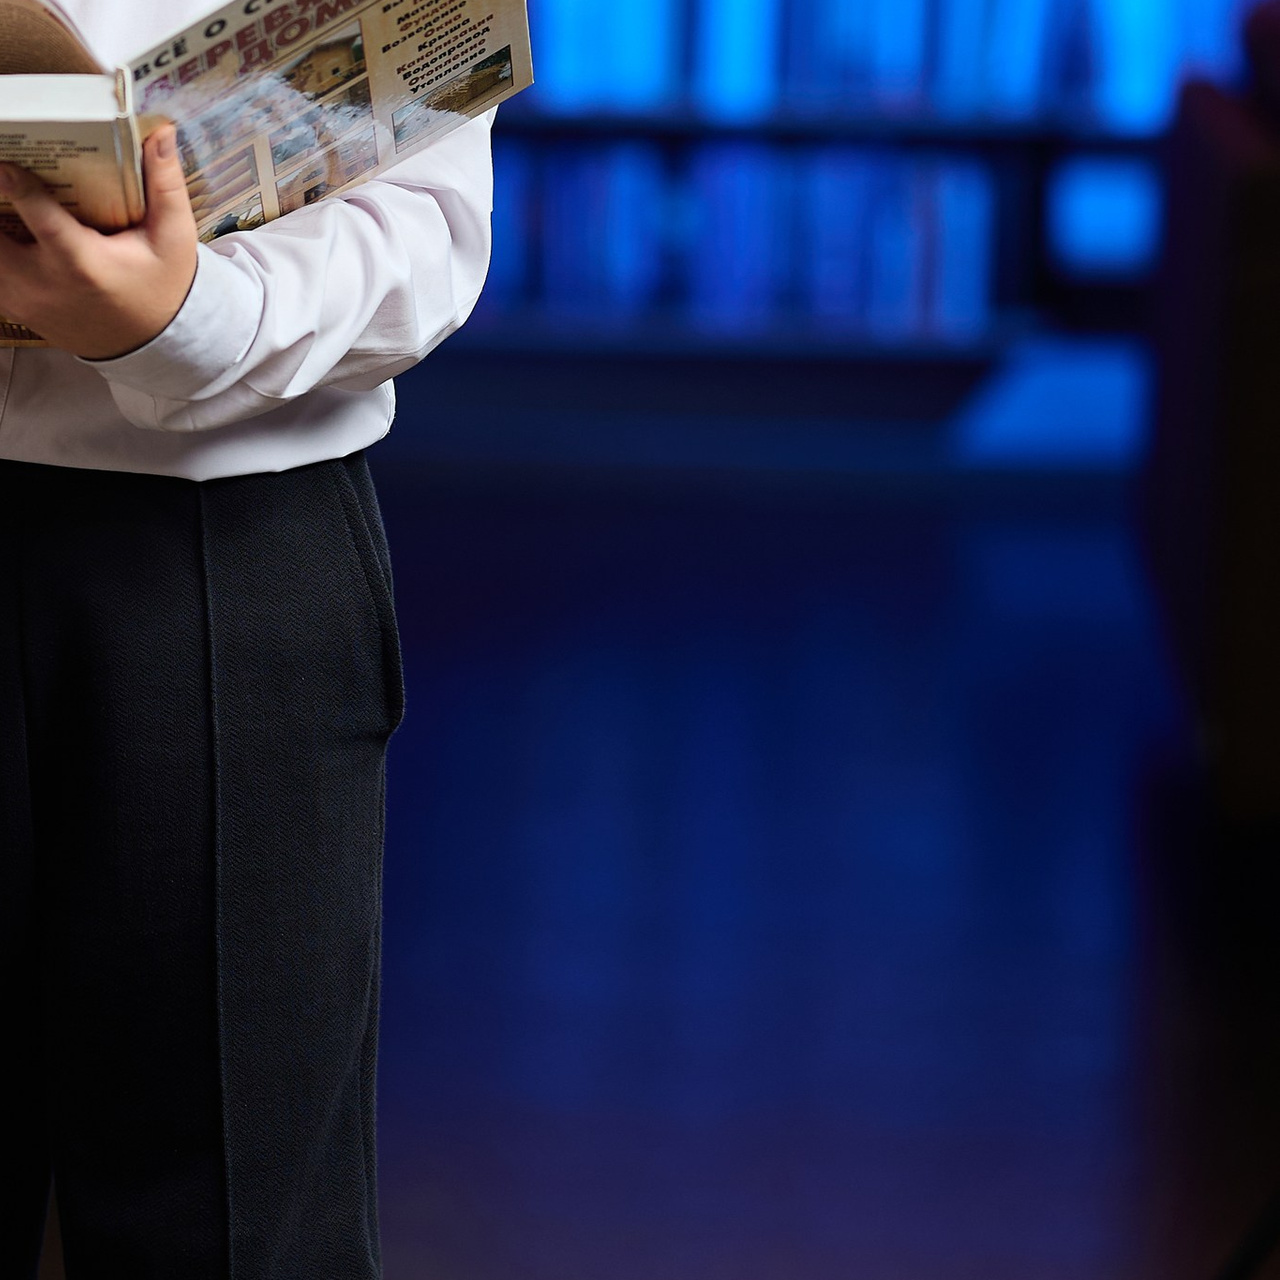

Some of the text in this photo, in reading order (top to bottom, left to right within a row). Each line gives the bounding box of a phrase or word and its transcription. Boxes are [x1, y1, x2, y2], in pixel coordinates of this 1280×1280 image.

[133, 36, 189, 83] ВСЁ
[203, 19, 227, 40] О
[381, 0, 467, 54] Возведение
[395, 12, 495, 76] Канализация
[417, 17, 471, 53] Крыша
[423, 12, 463, 39] Окна
[402, 25, 491, 81] Водопровод
[407, 37, 486, 87] Отопление
